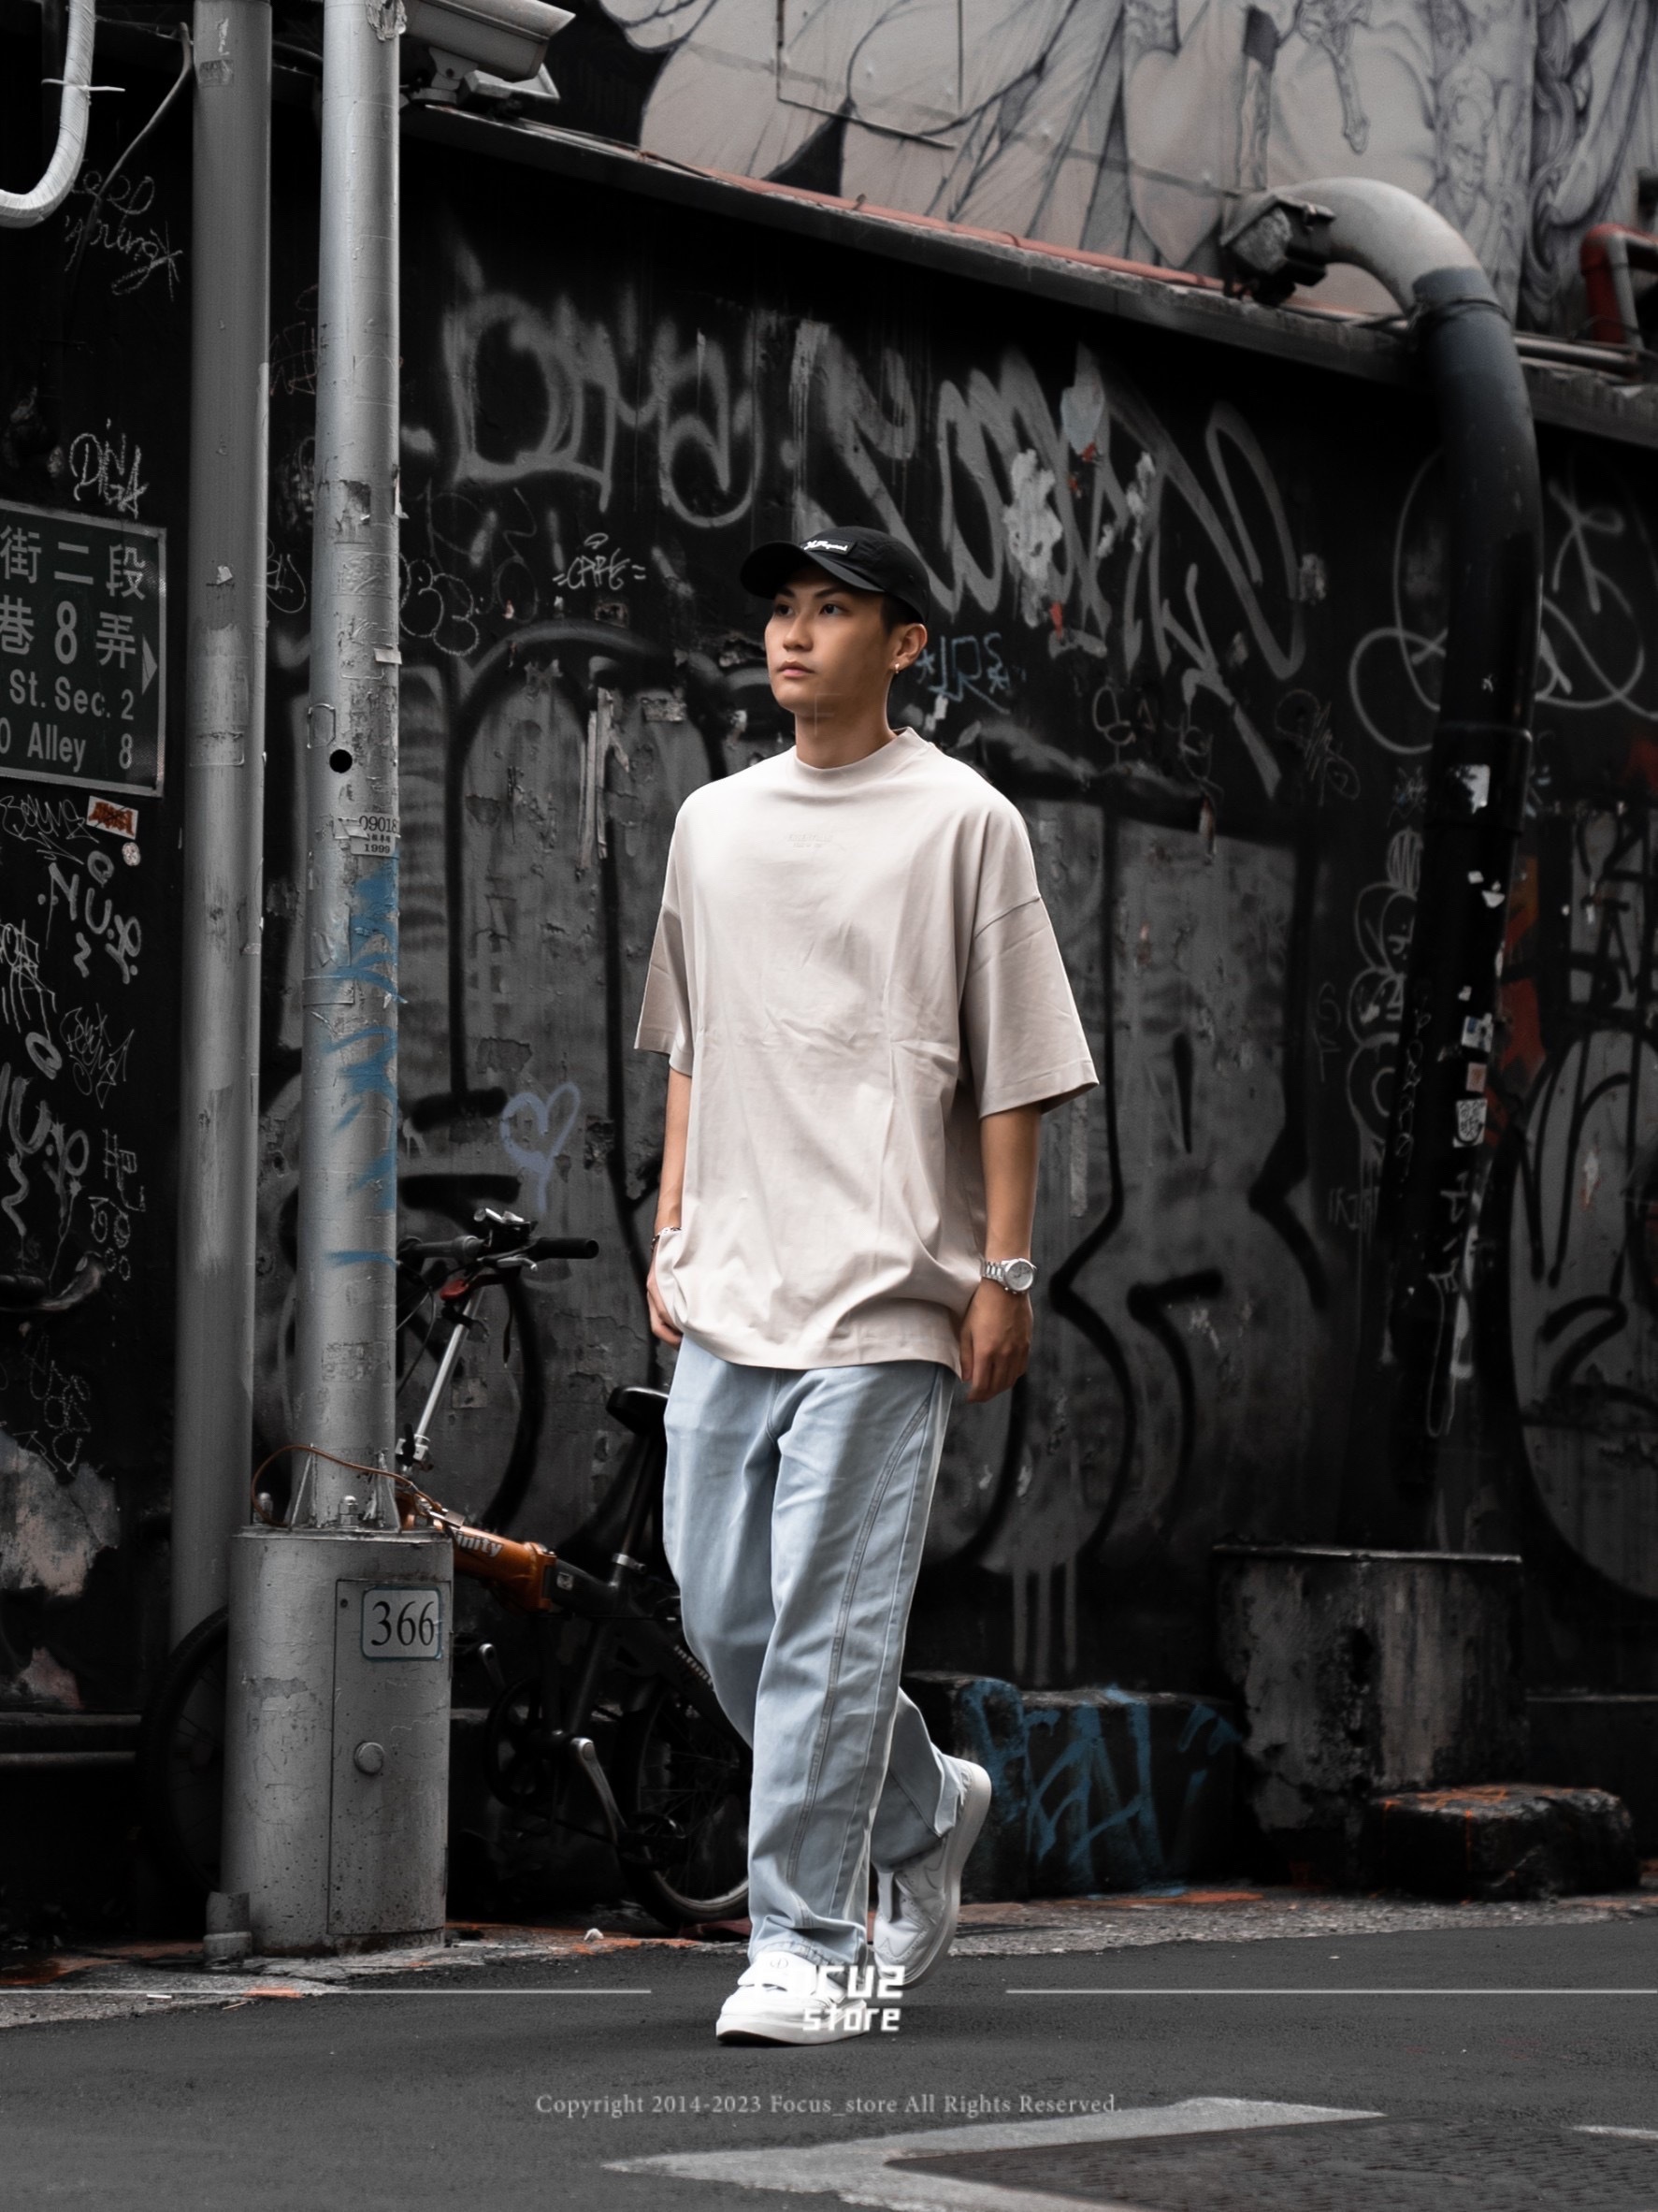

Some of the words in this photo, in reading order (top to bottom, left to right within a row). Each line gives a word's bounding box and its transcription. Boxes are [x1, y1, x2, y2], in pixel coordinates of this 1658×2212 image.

[121, 689, 135, 720] 2
[27, 721, 86, 773] Alley
[119, 733, 133, 770] 8
[370, 1600, 435, 1646] 366
